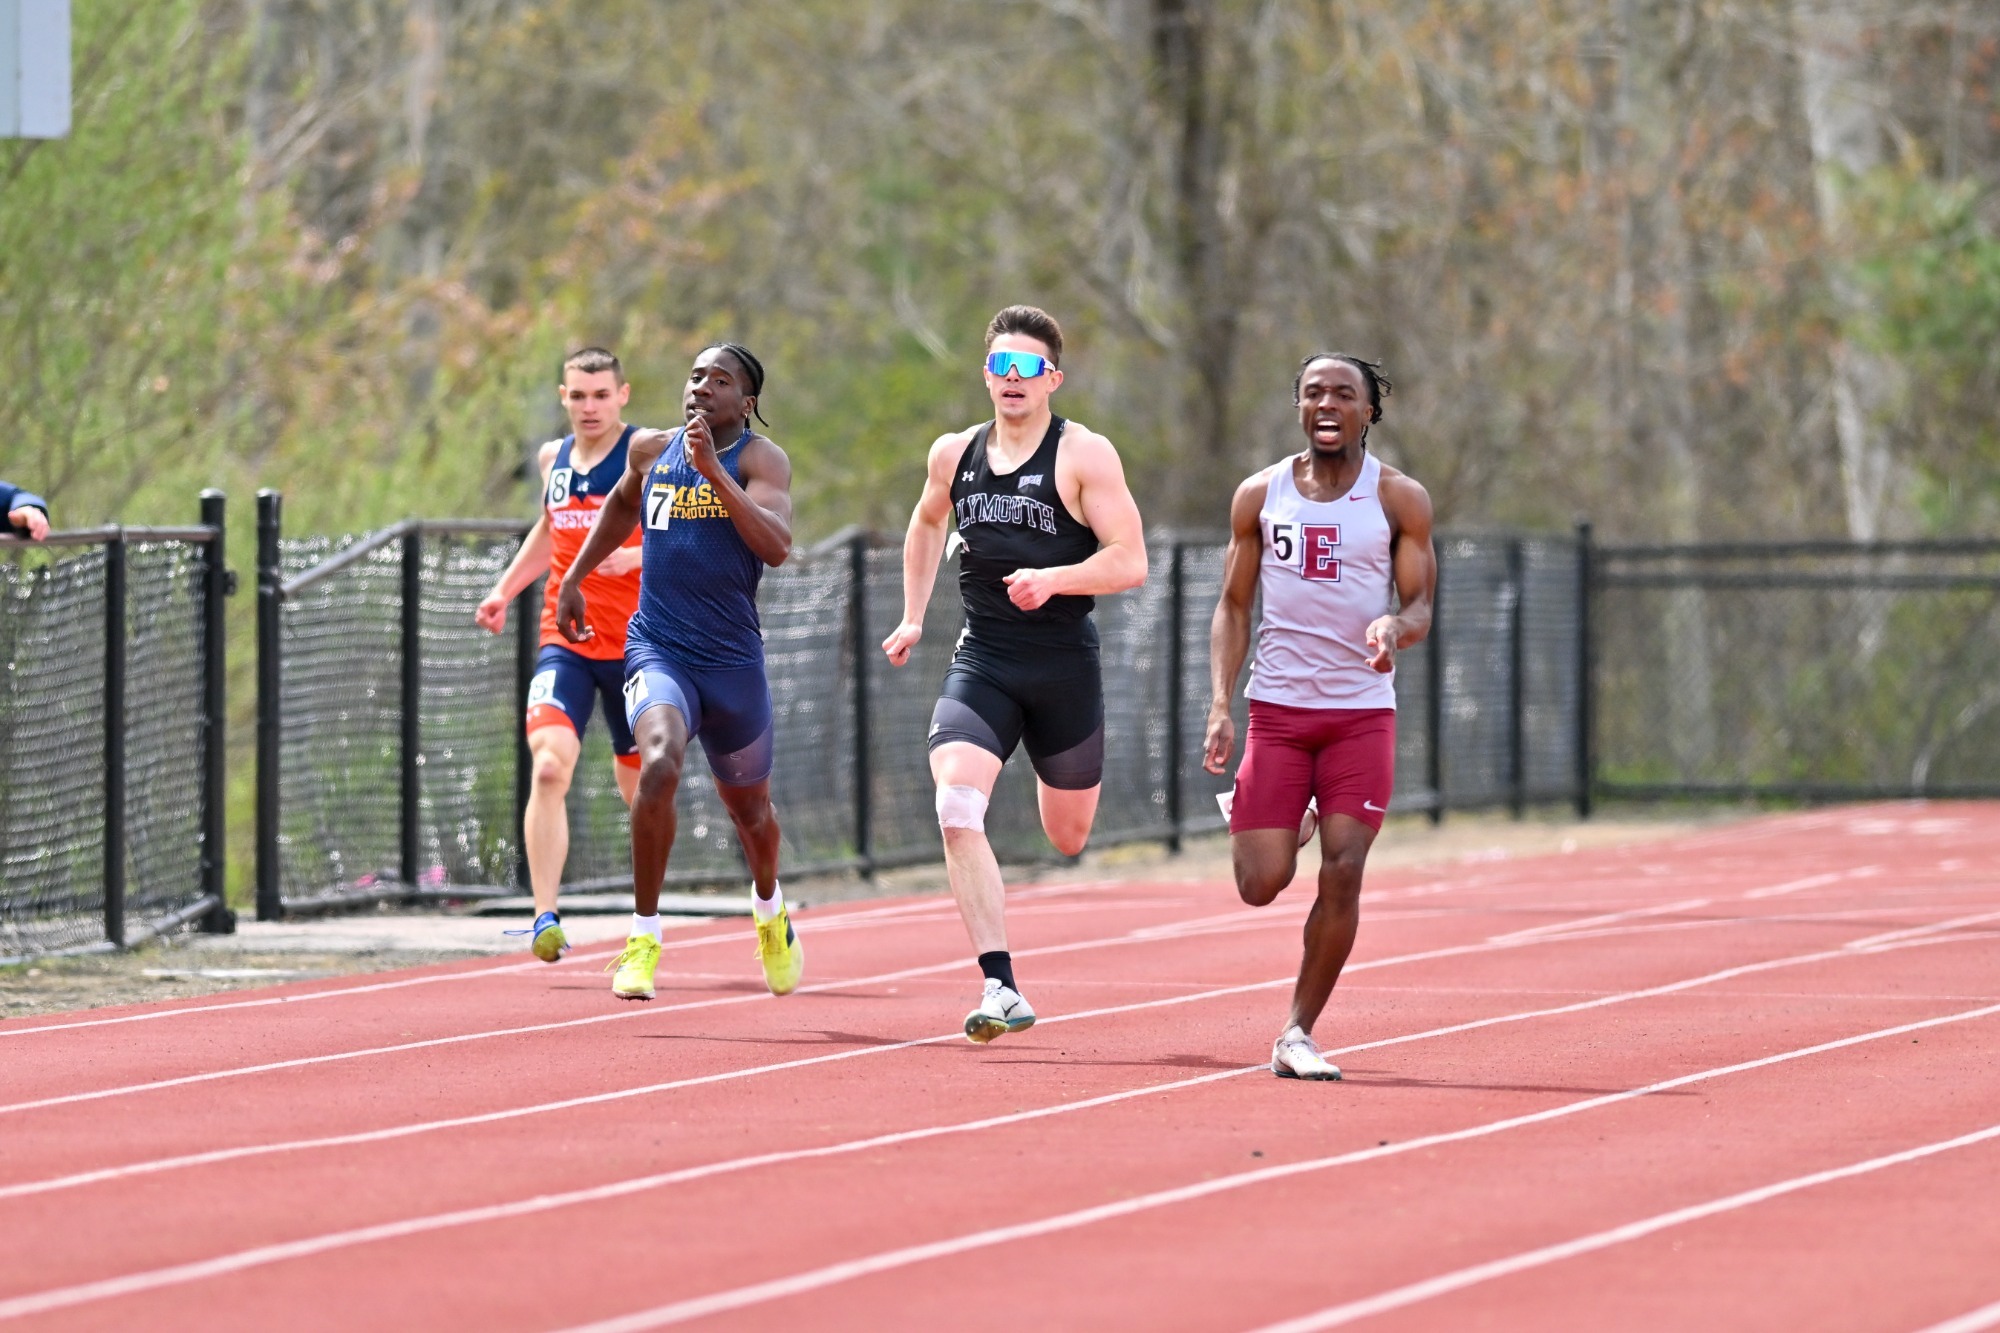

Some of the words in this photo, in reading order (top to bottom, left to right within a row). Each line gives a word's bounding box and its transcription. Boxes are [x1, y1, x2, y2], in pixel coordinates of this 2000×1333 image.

[553, 472, 566, 503] 8
[651, 491, 670, 526] 7
[956, 493, 1057, 535] LYMOUTH
[1272, 524, 1293, 561] 5
[1300, 524, 1341, 582] E
[624, 676, 640, 707] 7
